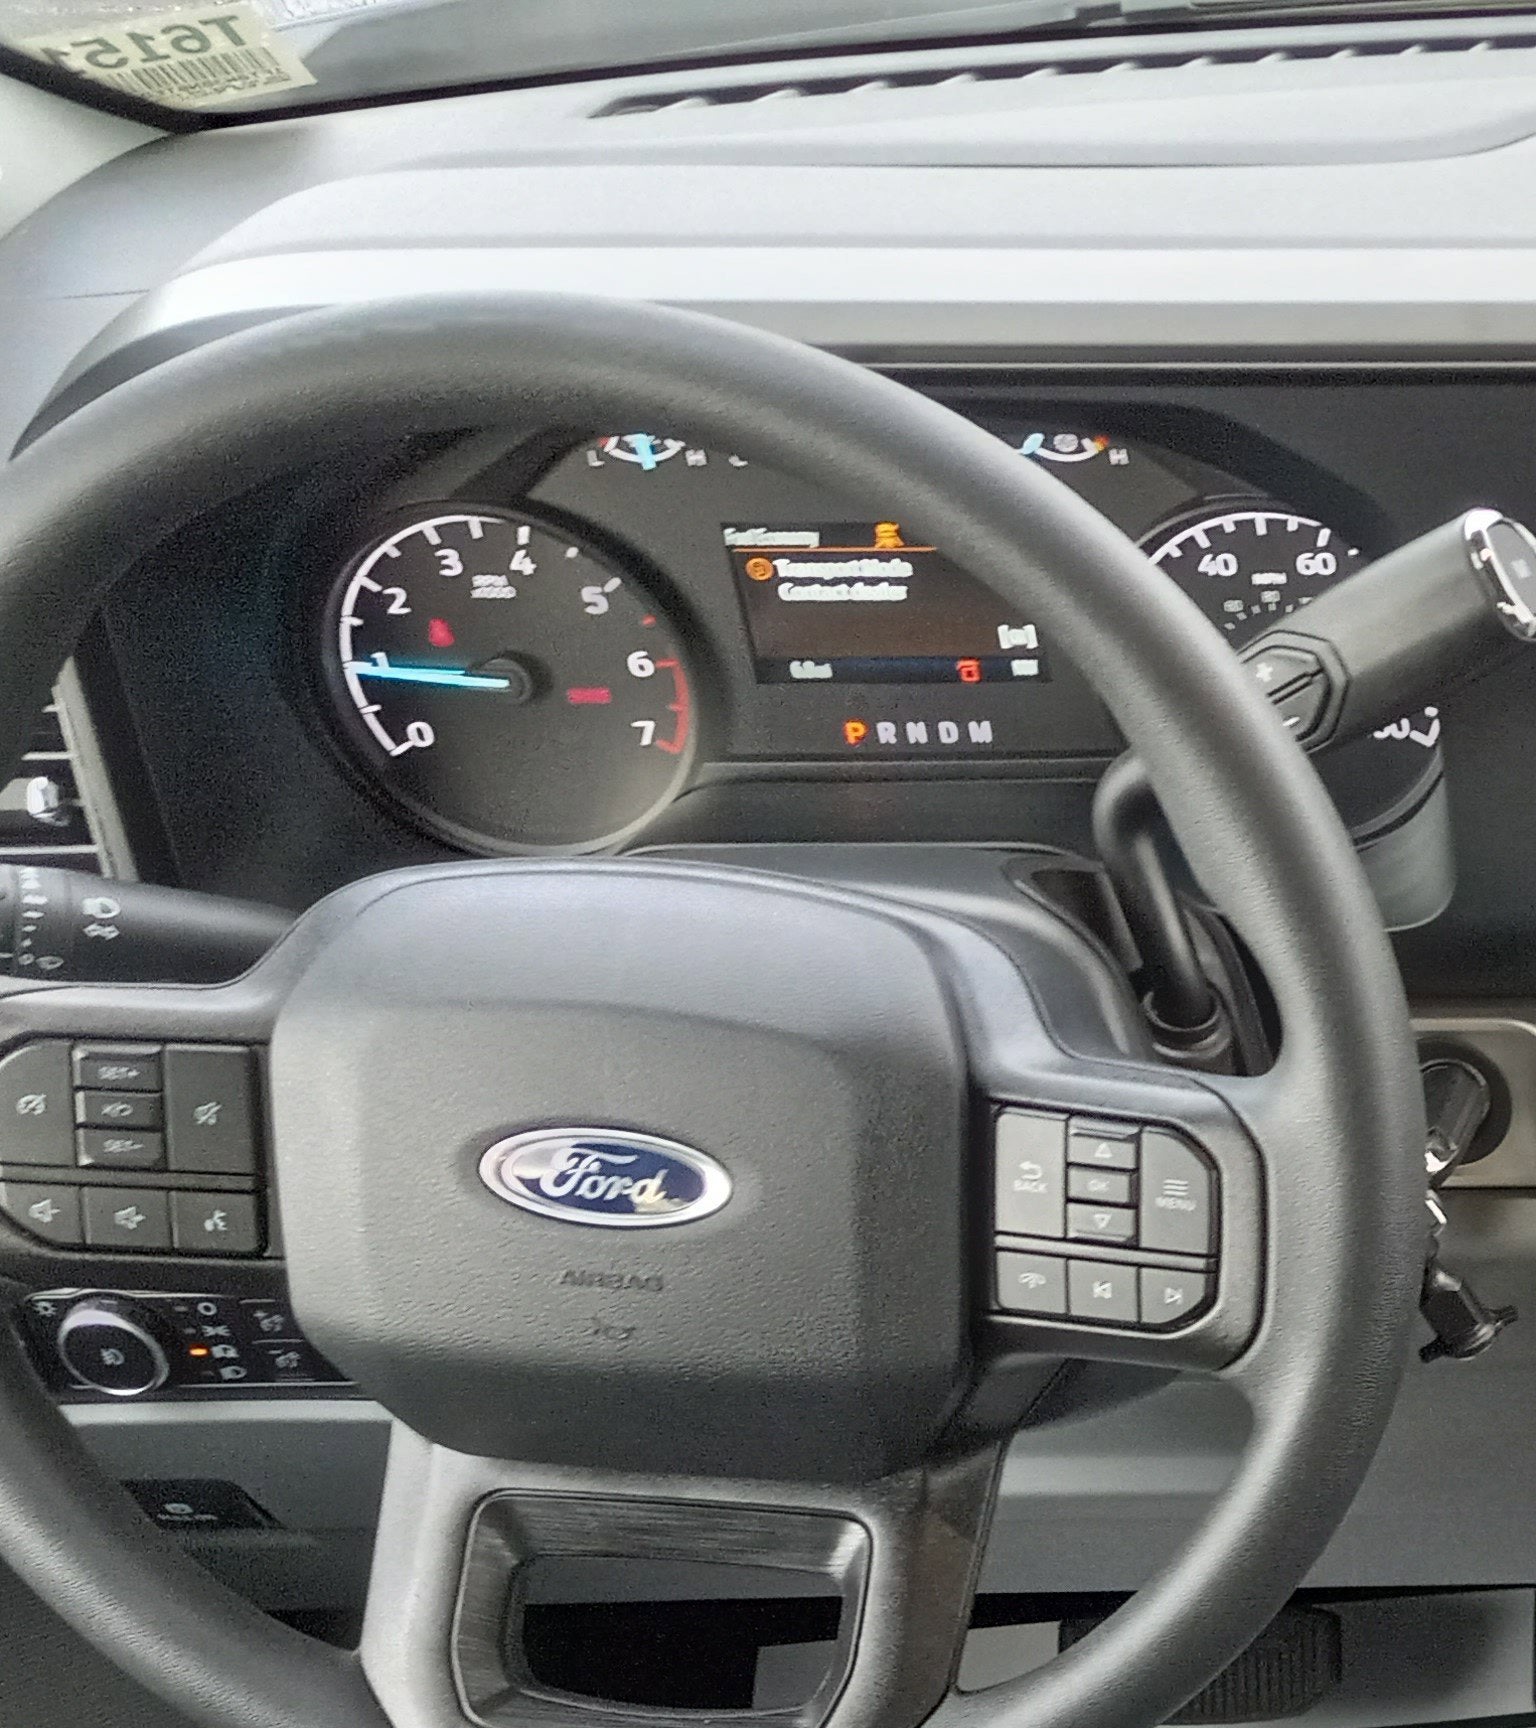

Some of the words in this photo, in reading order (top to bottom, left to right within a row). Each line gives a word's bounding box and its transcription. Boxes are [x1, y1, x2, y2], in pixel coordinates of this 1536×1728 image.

[434, 548, 464, 577] 3
[508, 549, 537, 576] 4
[1199, 553, 1239, 577] 40
[1296, 552, 1337, 577] 60
[382, 586, 412, 615] 2
[580, 585, 610, 615] 5
[626, 650, 656, 678] 6
[405, 720, 435, 748] 0
[630, 719, 656, 746] 7
[844, 718, 869, 744] P
[876, 720, 897, 744] R
[906, 720, 928, 744] N
[938, 720, 959, 744] D
[967, 720, 993, 743] M
[540, 1148, 670, 1202] Ford
